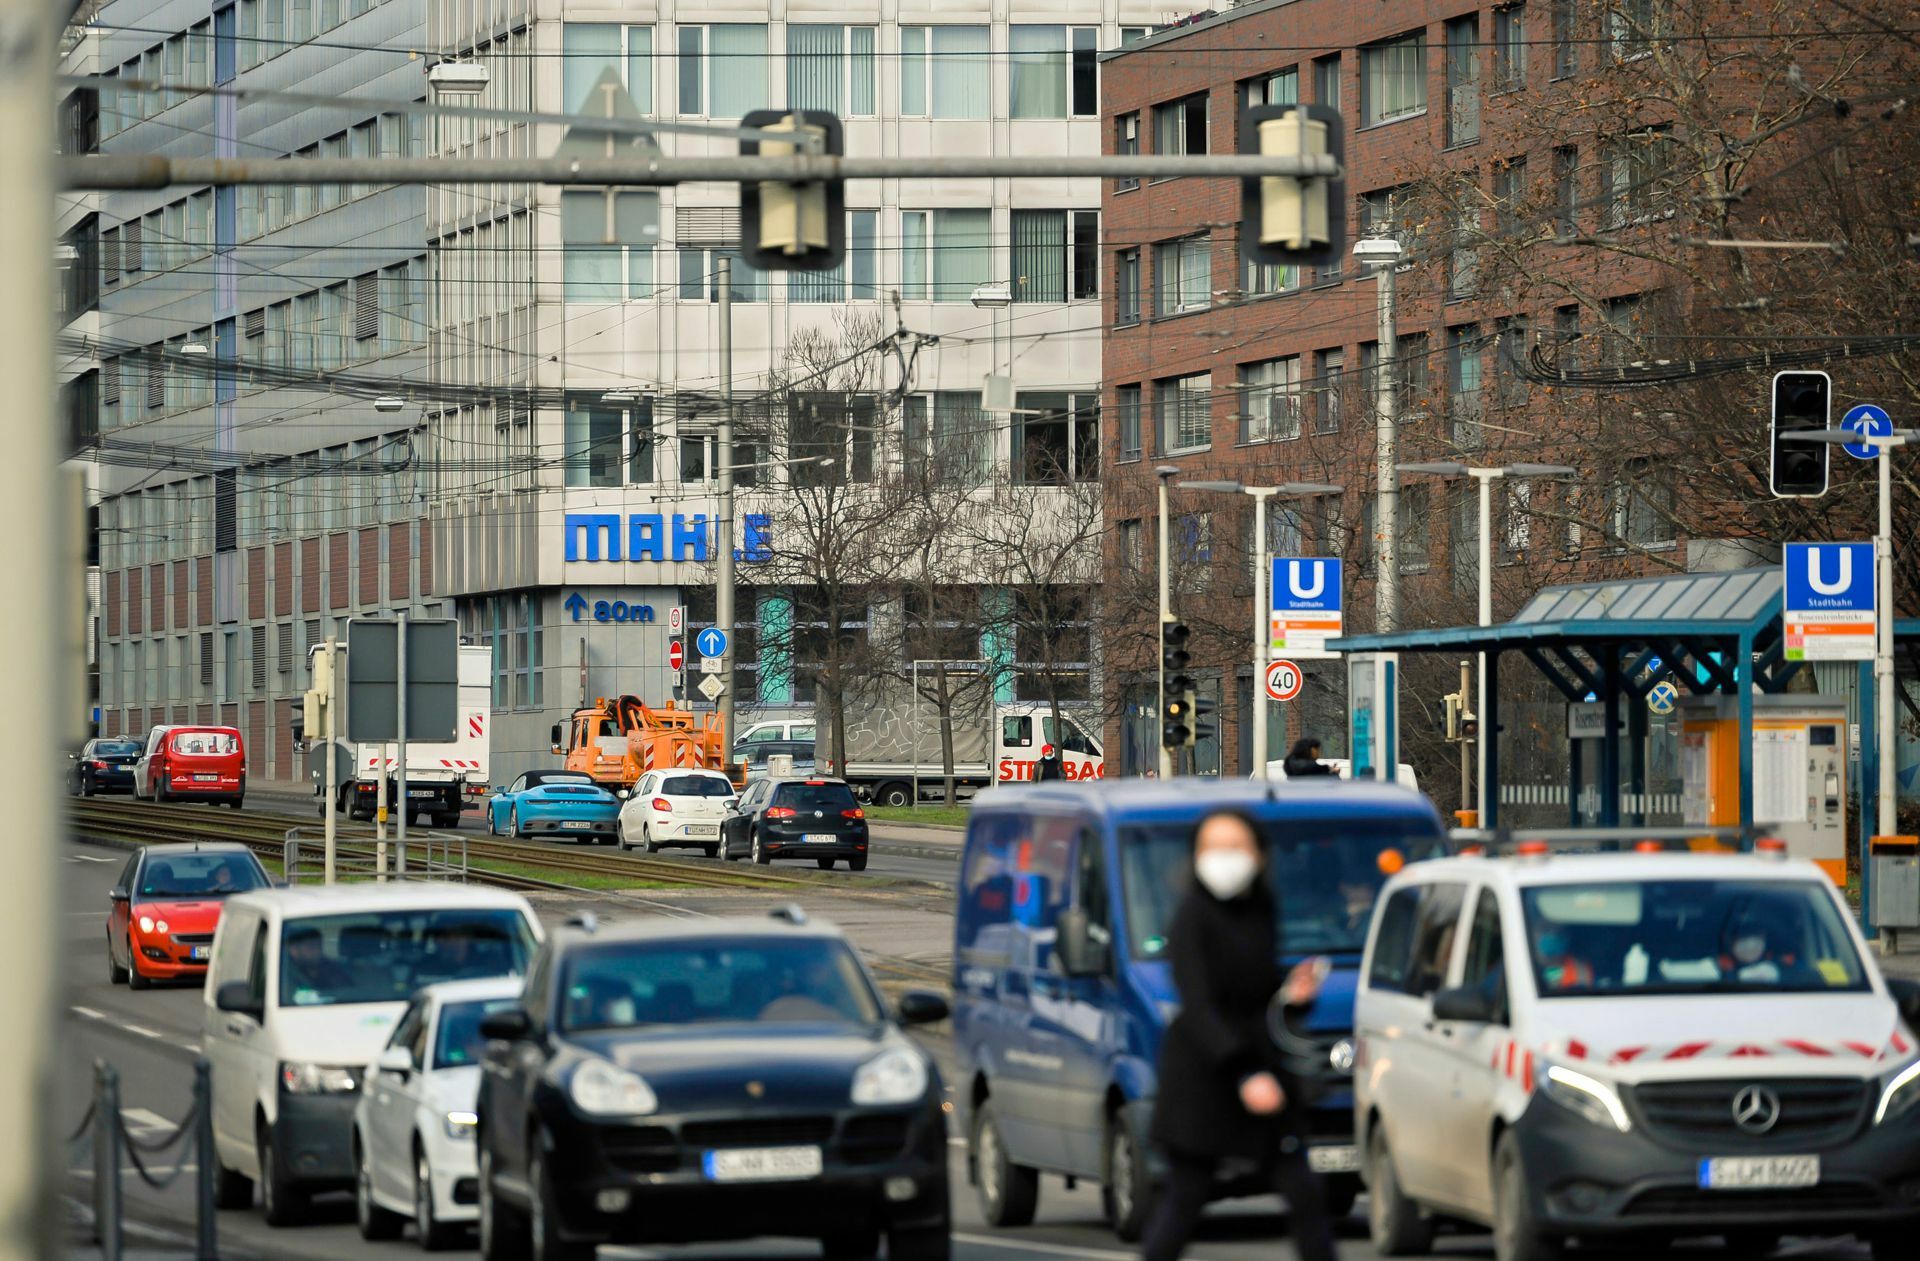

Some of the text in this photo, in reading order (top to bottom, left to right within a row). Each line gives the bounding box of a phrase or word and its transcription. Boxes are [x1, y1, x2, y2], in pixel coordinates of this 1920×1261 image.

[565, 514, 773, 562] MAHE
[1289, 561, 1324, 599] U
[1808, 547, 1852, 596] U
[594, 600, 655, 623] 80m
[1808, 598, 1853, 607] Stadtbahn
[1272, 672, 1294, 689] 40
